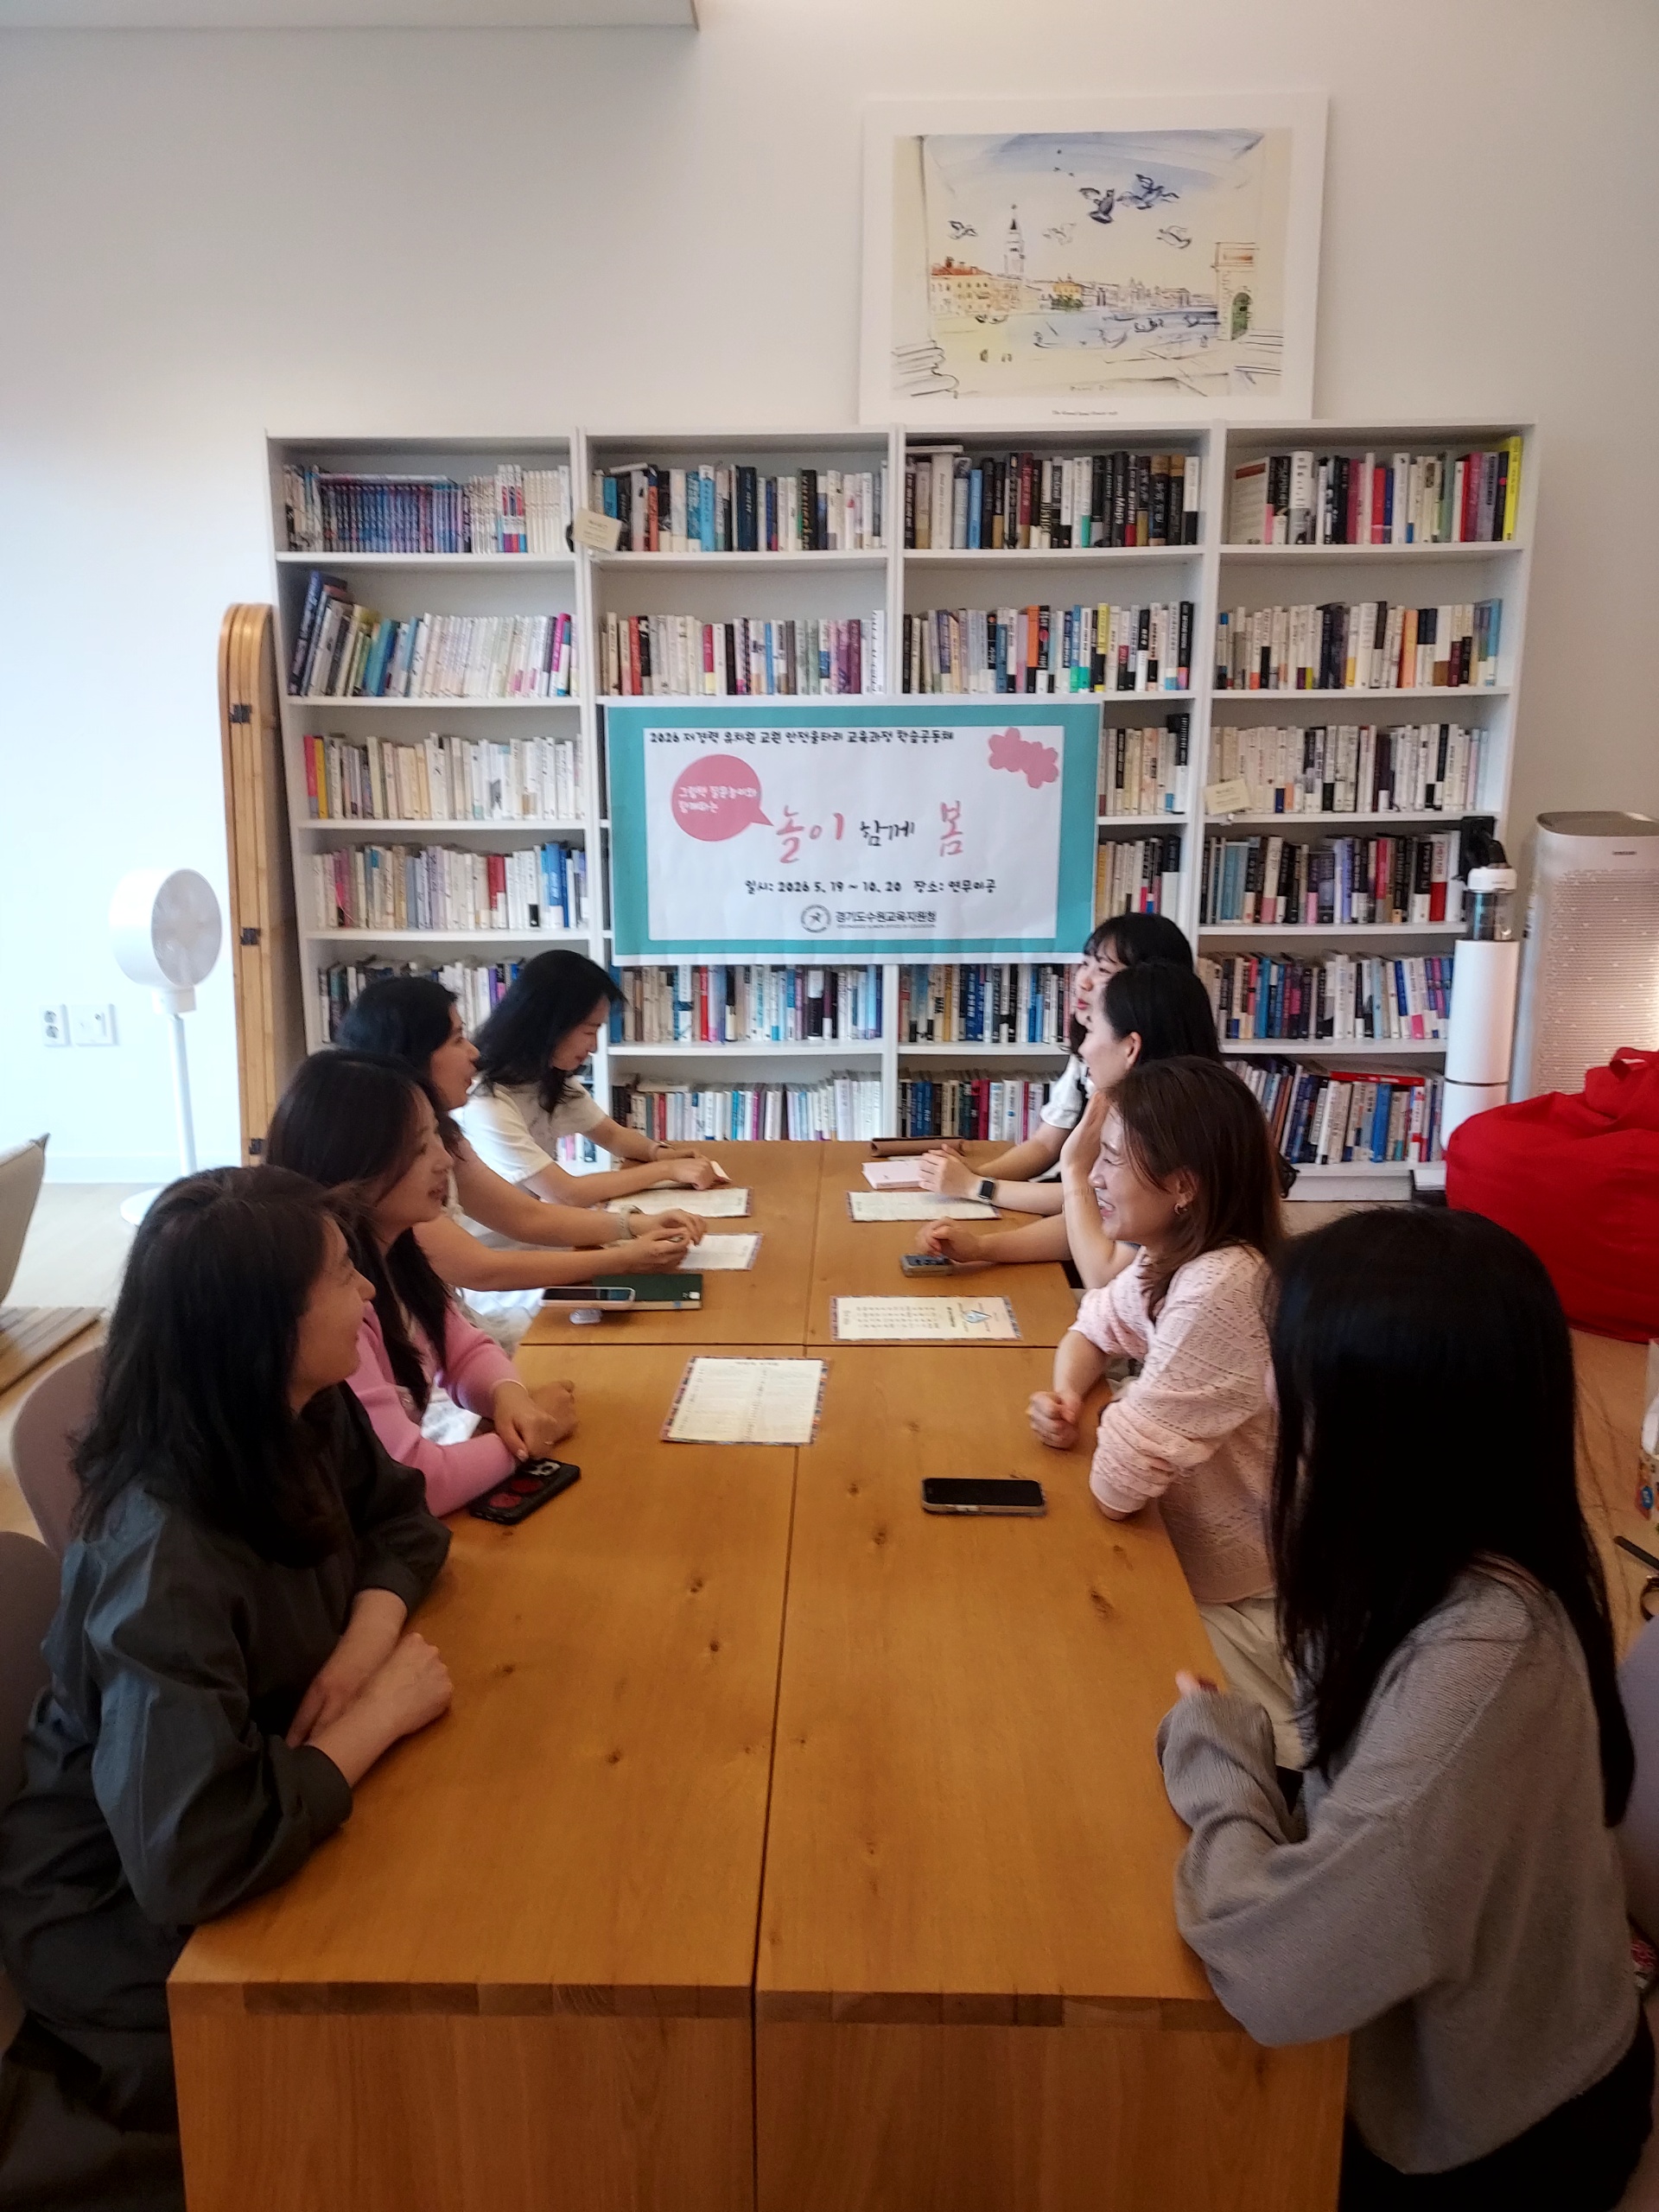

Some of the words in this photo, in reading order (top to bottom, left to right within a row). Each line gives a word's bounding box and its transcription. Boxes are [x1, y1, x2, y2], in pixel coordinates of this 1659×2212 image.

[1115, 497, 1126, 524] Maps
[650, 731, 680, 743] 2026
[723, 731, 756, 745] 유치원
[760, 731, 781, 745] 교원
[785, 730, 842, 744] 안전울타리
[847, 730, 893, 744] 교육과정
[896, 729, 954, 744] 학습공동체
[776, 804, 844, 864] 놀이
[860, 820, 915, 847] 함께
[939, 800, 963, 857] 봄
[745, 880, 773, 894] 일시:
[885, 881, 901, 892] 20
[913, 880, 944, 893] 장소:
[836, 911, 937, 923] 경기도수원교육지원청
